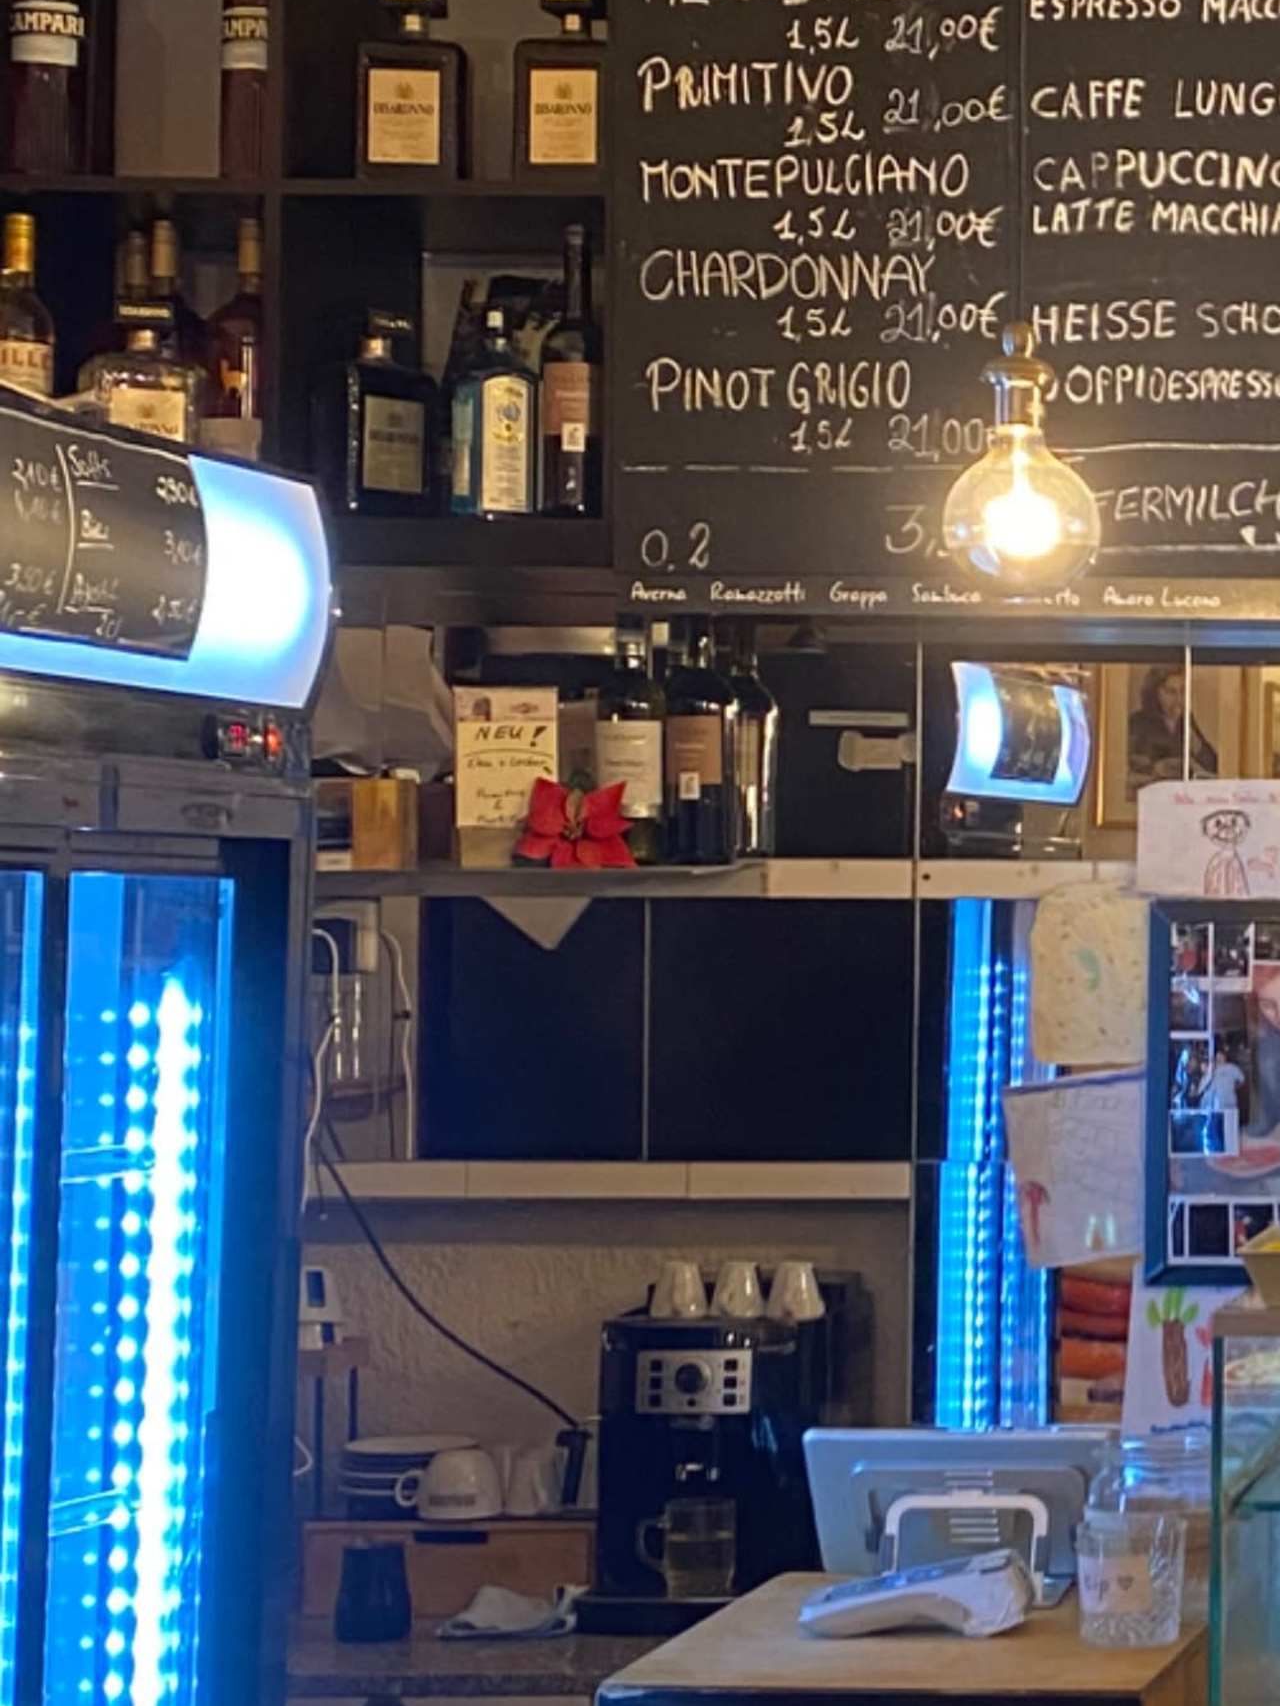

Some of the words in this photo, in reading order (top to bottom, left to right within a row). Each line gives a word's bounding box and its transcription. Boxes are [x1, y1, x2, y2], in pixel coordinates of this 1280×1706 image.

[637, 56, 853, 112] PRIMITIVO
[1030, 78, 1146, 120] CAFFE
[640, 152, 969, 203] MONTEPULCIANO
[1032, 197, 1135, 235] LATTE
[640, 249, 936, 302] CHARDONNAY
[1032, 299, 1176, 345] HEISSE
[645, 357, 776, 412] PINOT
[787, 359, 912, 413] GRIGIO
[630, 581, 687, 601] Averna
